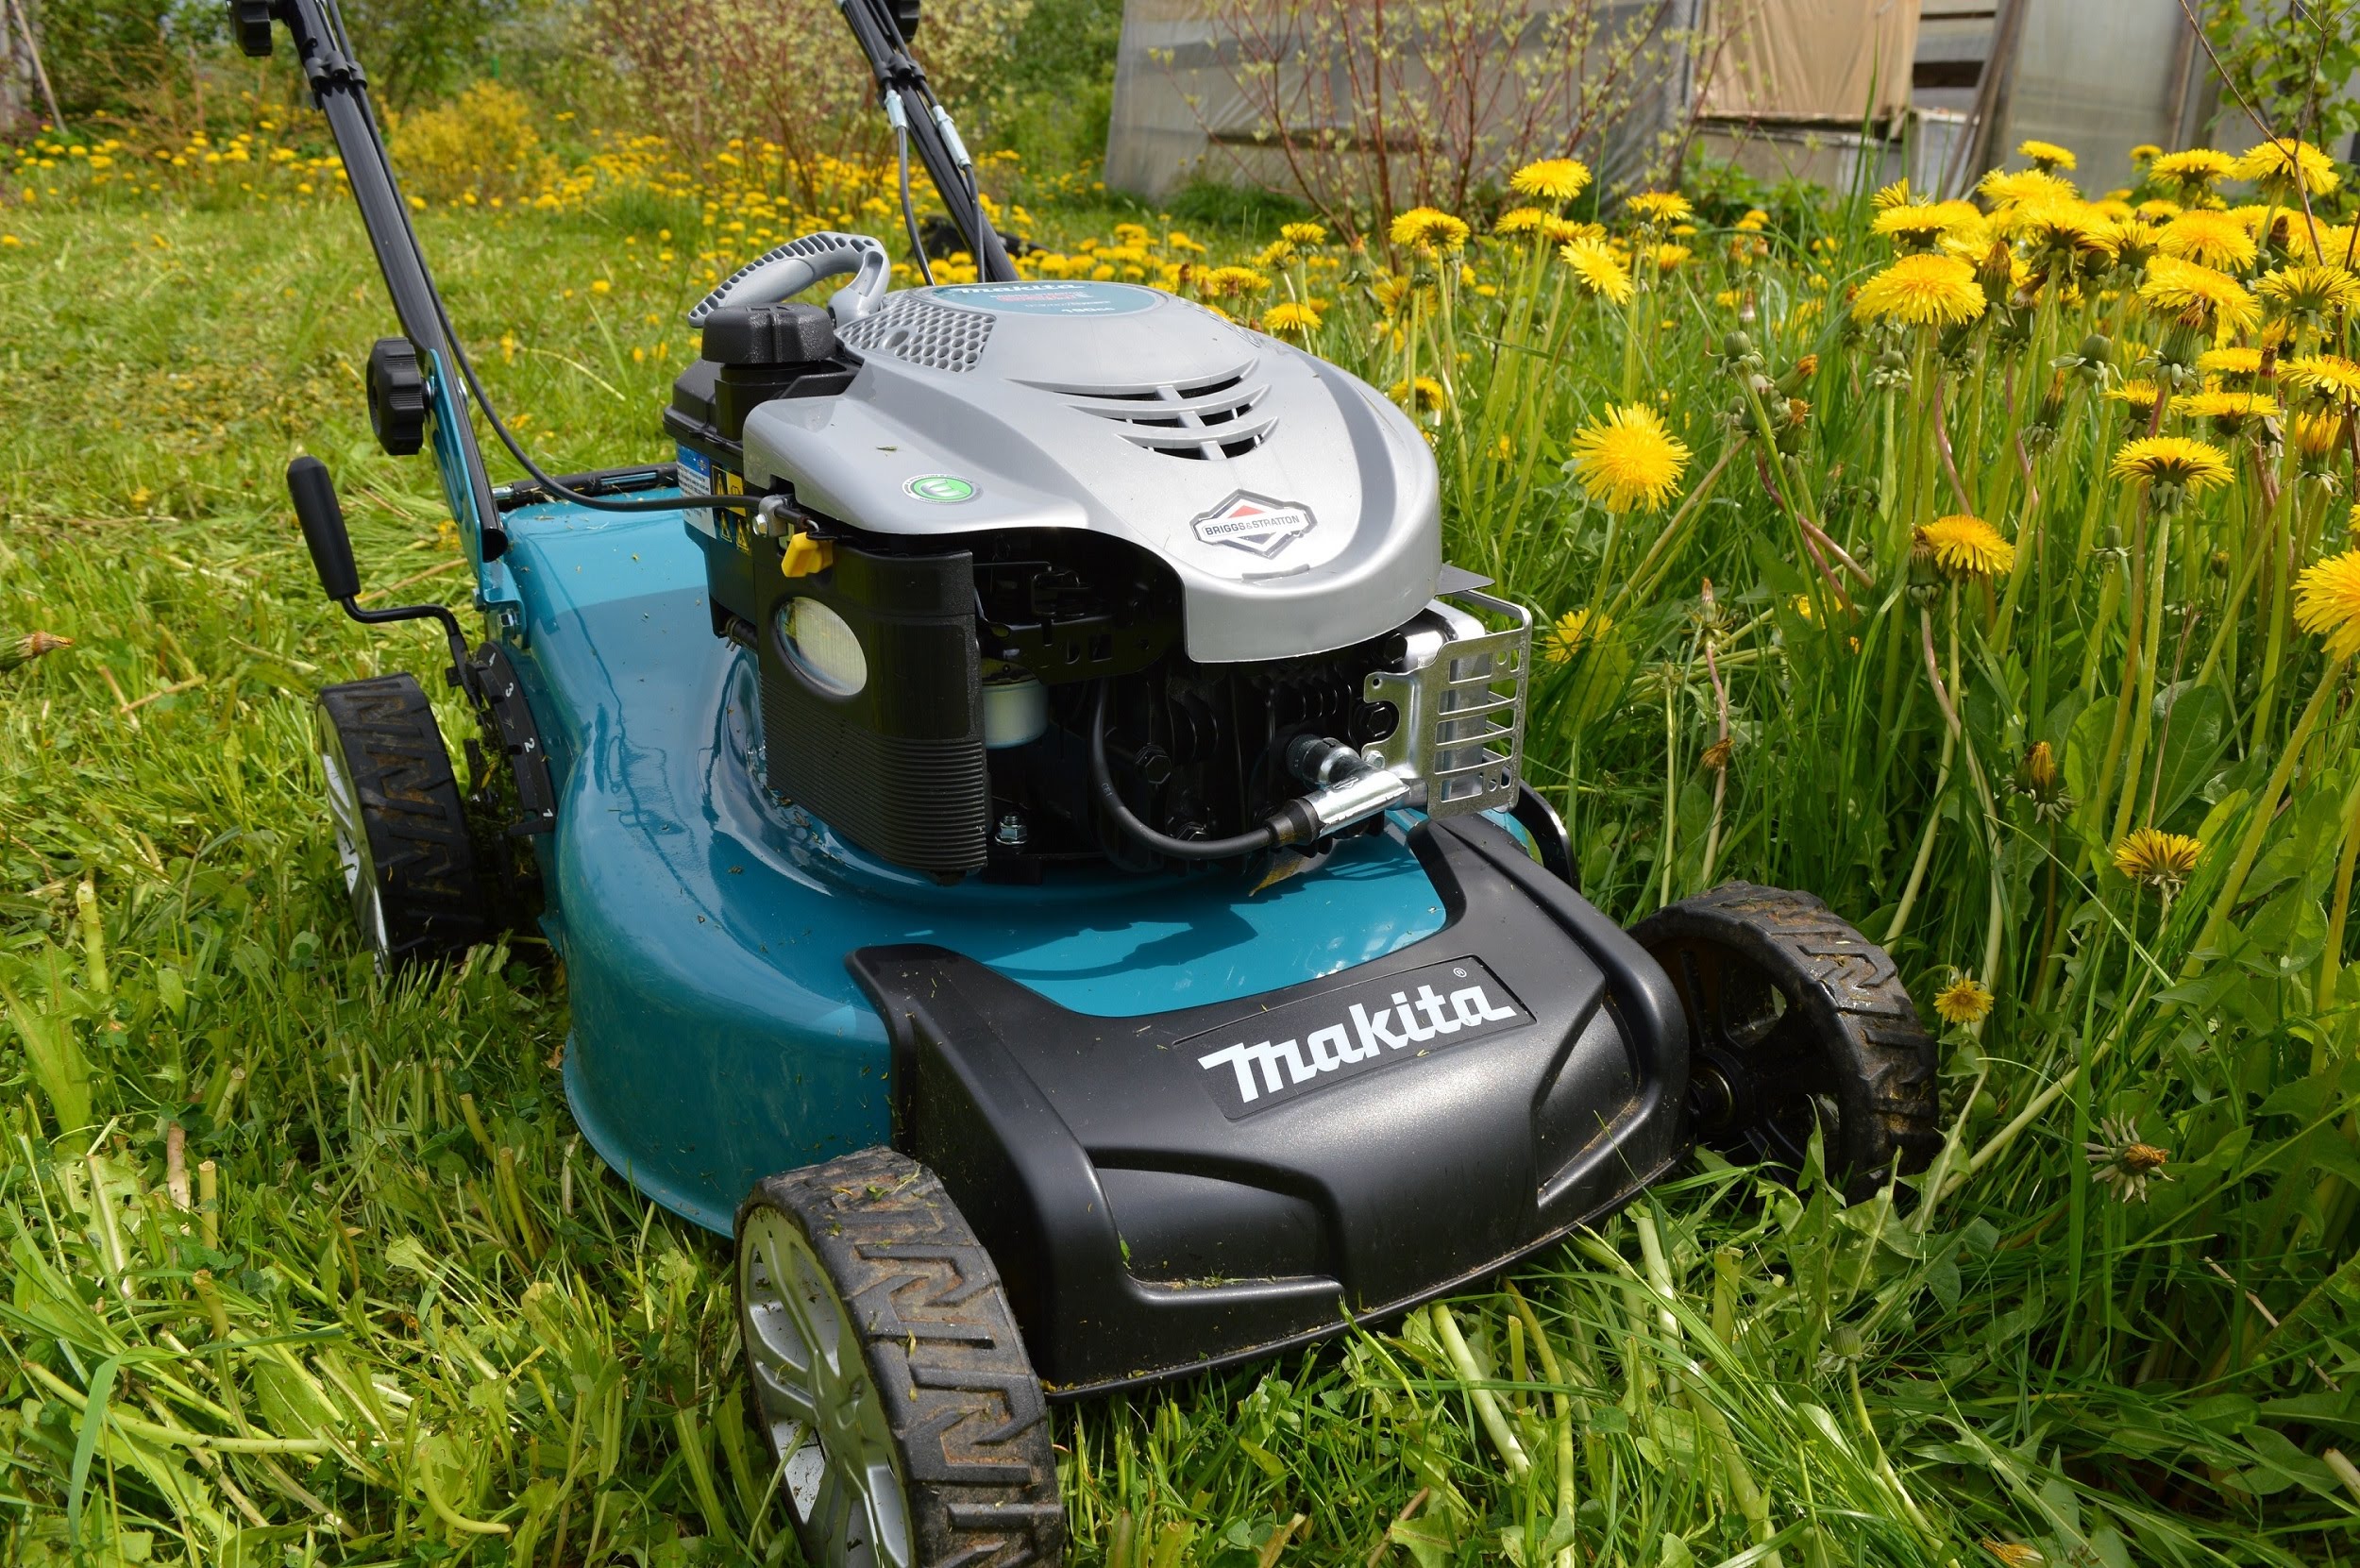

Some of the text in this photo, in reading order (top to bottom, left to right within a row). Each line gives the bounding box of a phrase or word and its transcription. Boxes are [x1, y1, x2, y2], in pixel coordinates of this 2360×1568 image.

[488, 652, 497, 666] 4
[505, 682, 514, 698] 3
[524, 737, 535, 752] 2
